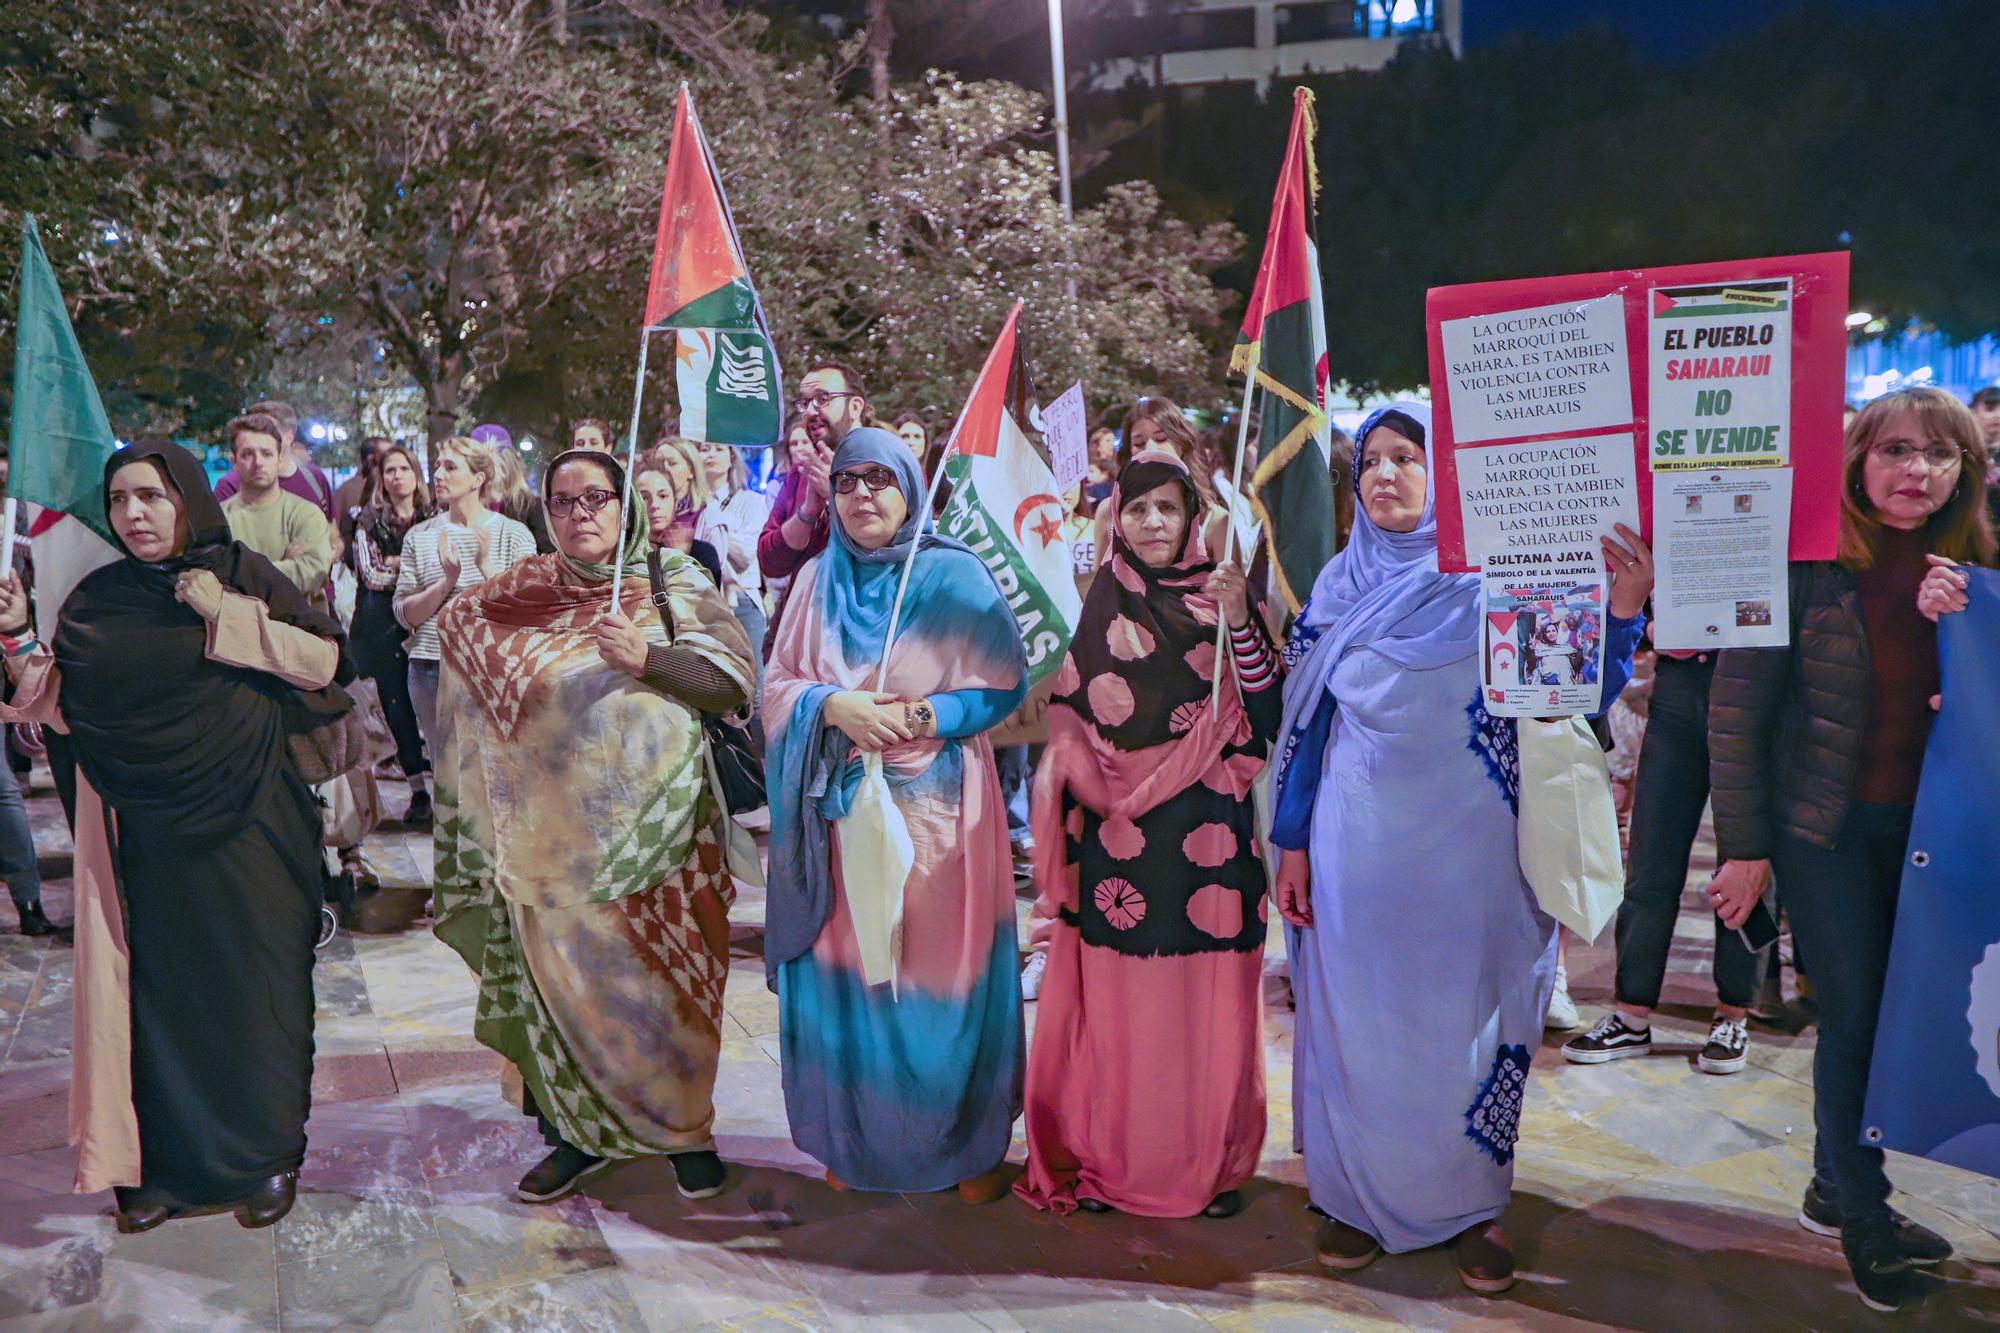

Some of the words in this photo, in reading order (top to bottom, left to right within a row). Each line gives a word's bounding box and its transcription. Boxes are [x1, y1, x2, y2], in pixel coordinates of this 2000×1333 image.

[1472, 325, 1493, 338] LA
[1496, 308, 1587, 333] OCUPACIÓN
[1473, 329, 1555, 355] MARROQUÍ
[1560, 327, 1590, 343] DEL
[1664, 329, 1688, 350] EL
[1693, 324, 1774, 349] PUEBLO
[1452, 356, 1519, 376] SAHARA,
[1522, 352, 1540, 367] ES
[1544, 341, 1616, 363] TAMBIEN
[1665, 354, 1771, 381] SAHARAUI
[1460, 371, 1542, 391] VIOLENCIA
[1545, 361, 1611, 382] CONTRA
[1486, 391, 1514, 406] LAS
[1518, 381, 1586, 401] MUJERES
[1695, 389, 1732, 417] NO
[1494, 400, 1581, 422] SAHARAUIS
[1655, 429, 1689, 456] SE
[1695, 425, 1780, 454] VENDE
[1485, 455, 1505, 467] LA
[1508, 443, 1597, 465] OCUPACIÓN
[1689, 461, 1698, 469] LA
[1485, 463, 1566, 484] MARROQUÍ
[1570, 463, 1600, 477] DEL
[1466, 488, 1531, 502] SAHARA,
[1534, 484, 1551, 496] ES
[1554, 477, 1625, 495] TAMBIEN
[1473, 501, 1554, 517] VIOLENCIA
[1557, 495, 1620, 511] CONTRA
[1499, 518, 1527, 531] LAS
[1531, 514, 1598, 530] MUJERES
[1508, 530, 1593, 547] SAHARAUIS
[1488, 553, 1552, 565] SULTANA
[1557, 551, 1594, 562] JAYA
[1486, 569, 1523, 579] SÍMBOLO
[1526, 569, 1537, 577] DE
[1555, 566, 1596, 575] VALENTÍA
[1518, 582, 1534, 590] LAS
[1537, 581, 1577, 589] MUJERES
[1516, 594, 1565, 603] SAHARAUIS
